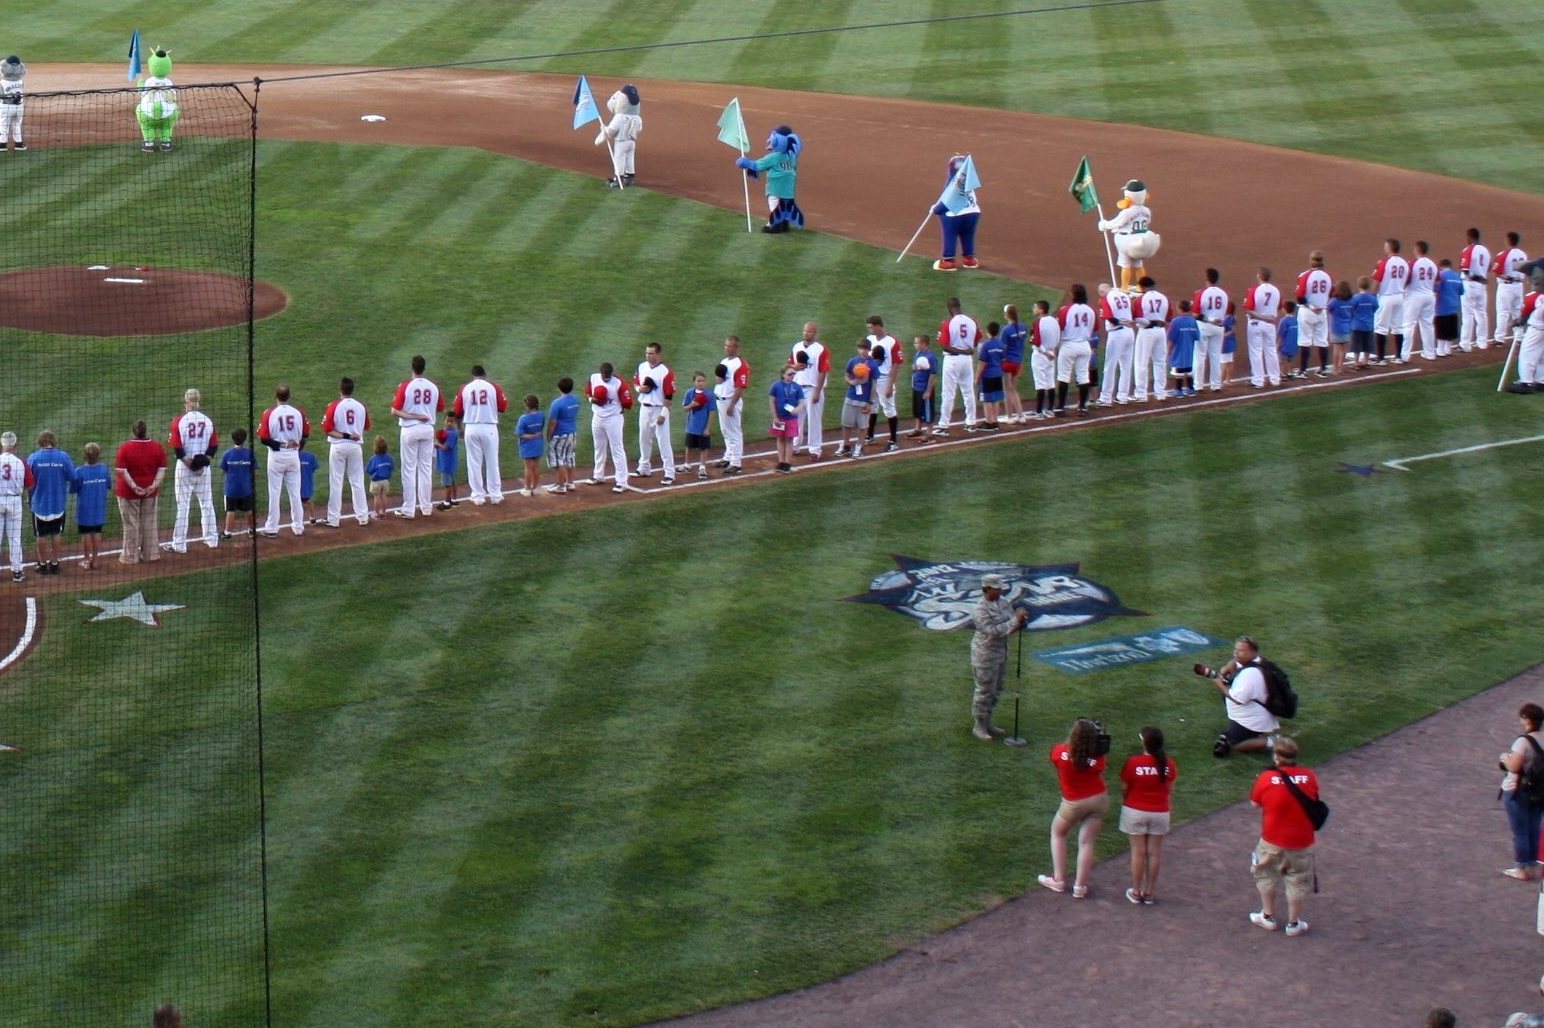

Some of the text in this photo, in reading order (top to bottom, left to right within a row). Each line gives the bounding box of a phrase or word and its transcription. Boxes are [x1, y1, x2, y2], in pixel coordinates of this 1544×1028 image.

[779, 161, 791, 171] 98
[1391, 265, 1405, 279] 20
[1419, 266, 1433, 280] 24
[1311, 280, 1326, 294] 26
[1113, 296, 1128, 309] 25
[1148, 299, 1162, 313] 17
[1208, 296, 1223, 310] 16
[1264, 292, 1272, 307] 7
[1073, 312, 1089, 327] 14
[959, 325, 967, 339] 5
[413, 389, 431, 405] 28
[470, 389, 488, 405] 12
[278, 415, 295, 432] 15
[346, 409, 355, 425] 6
[187, 421, 206, 439] 27
[2, 463, 11, 481] 3
[1136, 766, 1170, 776] STAF
